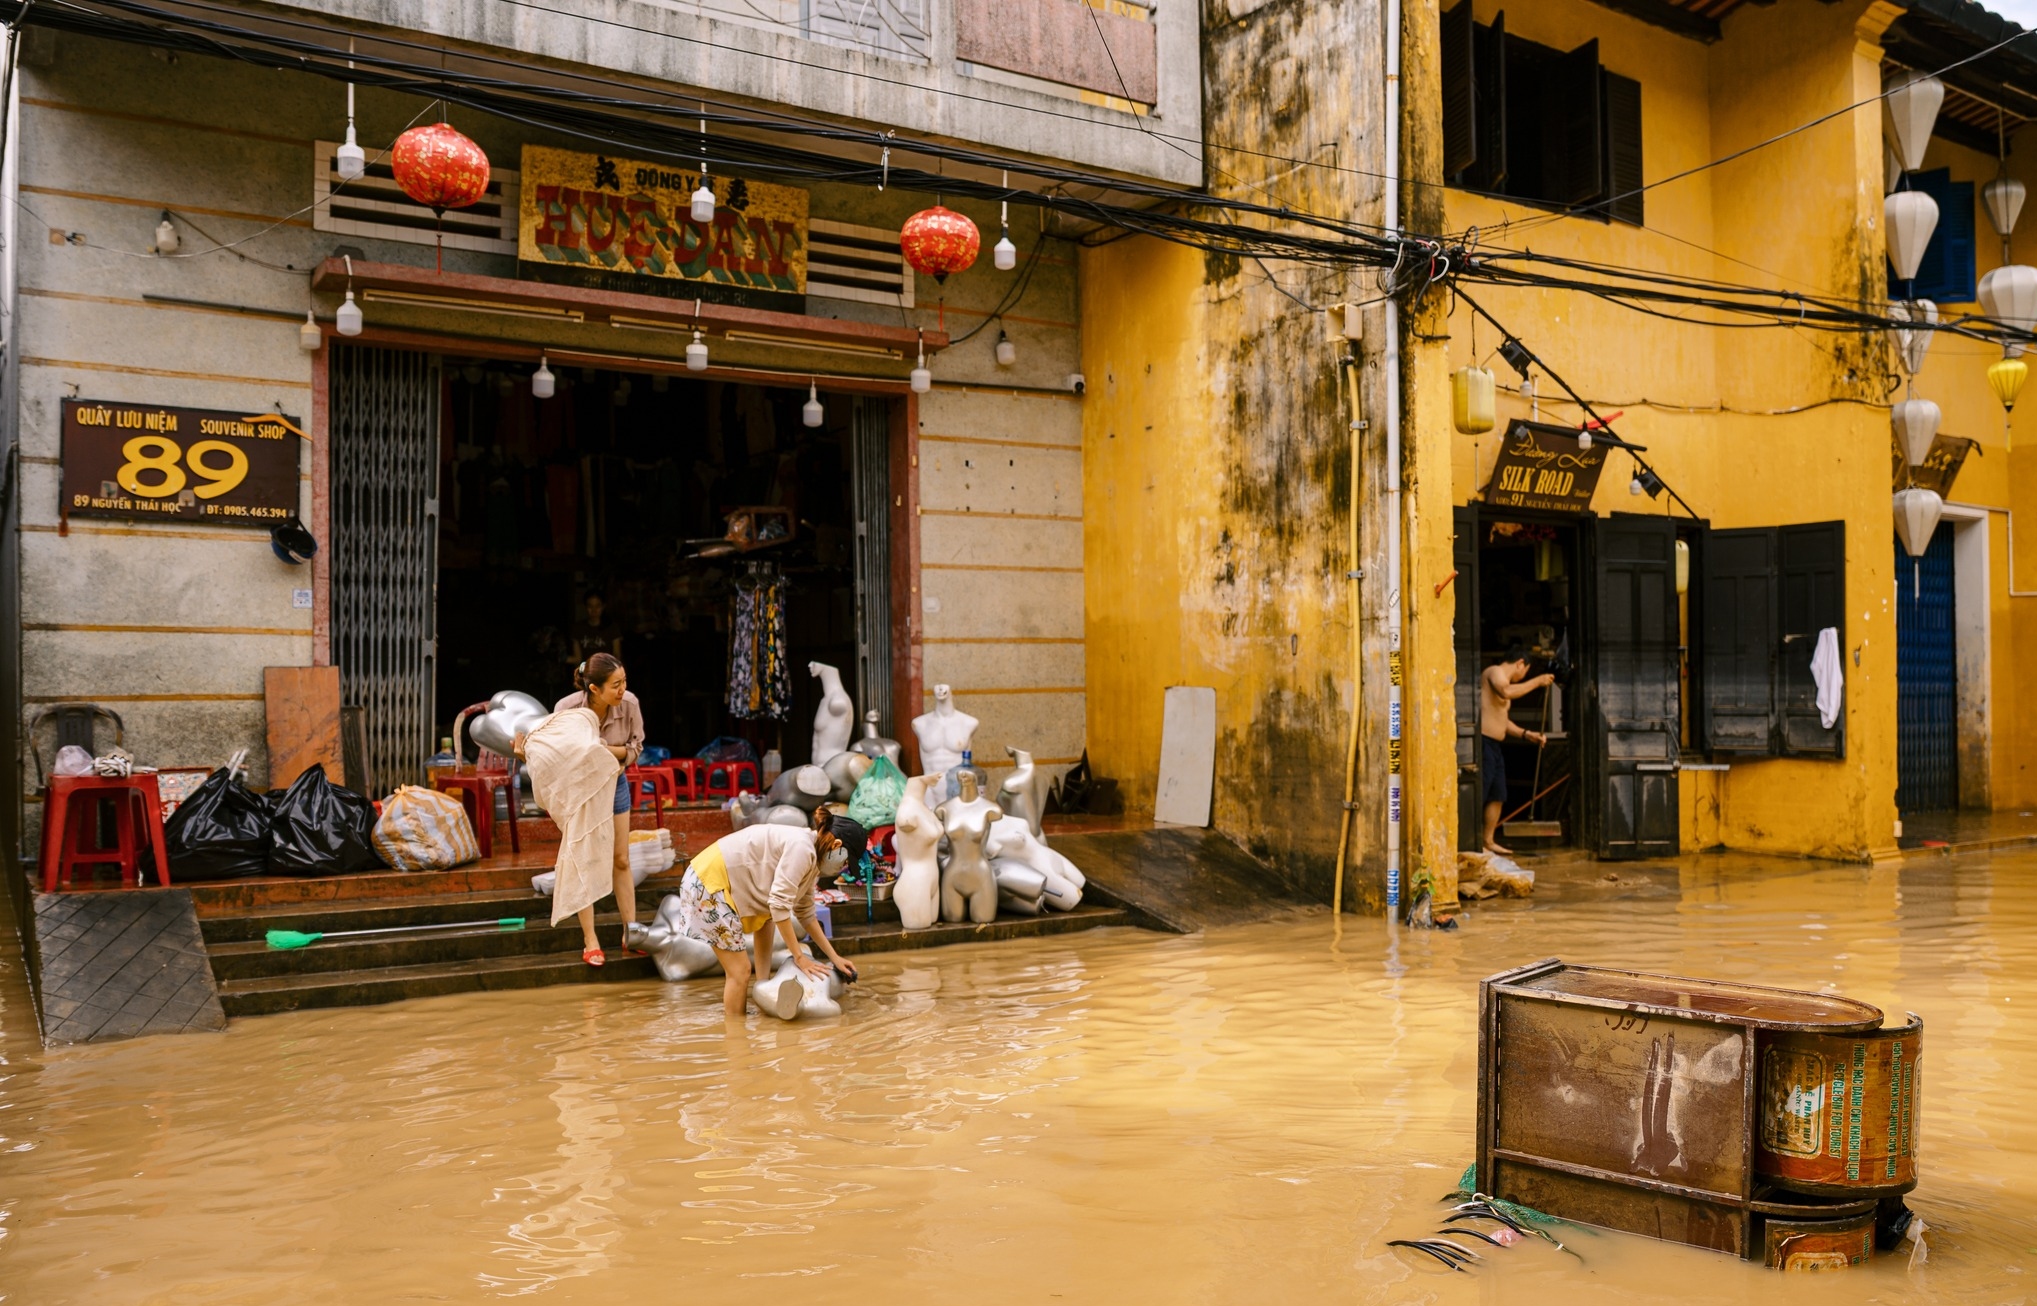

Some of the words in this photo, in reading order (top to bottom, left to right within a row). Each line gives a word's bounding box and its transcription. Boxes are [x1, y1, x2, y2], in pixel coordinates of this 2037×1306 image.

[685, 175, 695, 192] Y
[116, 410, 142, 429] LƯU
[145, 410, 178, 433] NIỆM
[200, 419, 255, 437] SOUVENIR
[258, 424, 287, 440] SHOP
[116, 435, 249, 499] 89
[1498, 465, 1535, 492] SILK
[1533, 469, 1574, 496] ROAD
[73, 494, 90, 507] 89
[91, 496, 131, 510] NGUYỄN
[135, 499, 159, 511] THÁI
[161, 502, 182, 515] HỌC
[1510, 493, 1524, 507] 91
[1853, 1043, 1866, 1067] THÙNG
[1892, 1060, 1901, 1071] DU
[1832, 1063, 1845, 1095] RECYCLE
[1852, 1069, 1866, 1084] RÁC
[1831, 1095, 1843, 1110] BIN
[1850, 1085, 1864, 1107] DÀNH
[1889, 1098, 1899, 1113] CHO
[1830, 1111, 1842, 1127] FOR
[1849, 1108, 1861, 1123] CHO
[1829, 1127, 1841, 1158] TOURIST
[1848, 1125, 1863, 1150] KHÁCH
[1901, 1125, 1909, 1156] RECYCLE
[1847, 1151, 1859, 1162] DU
[1845, 1163, 1859, 1180] LỊCH
